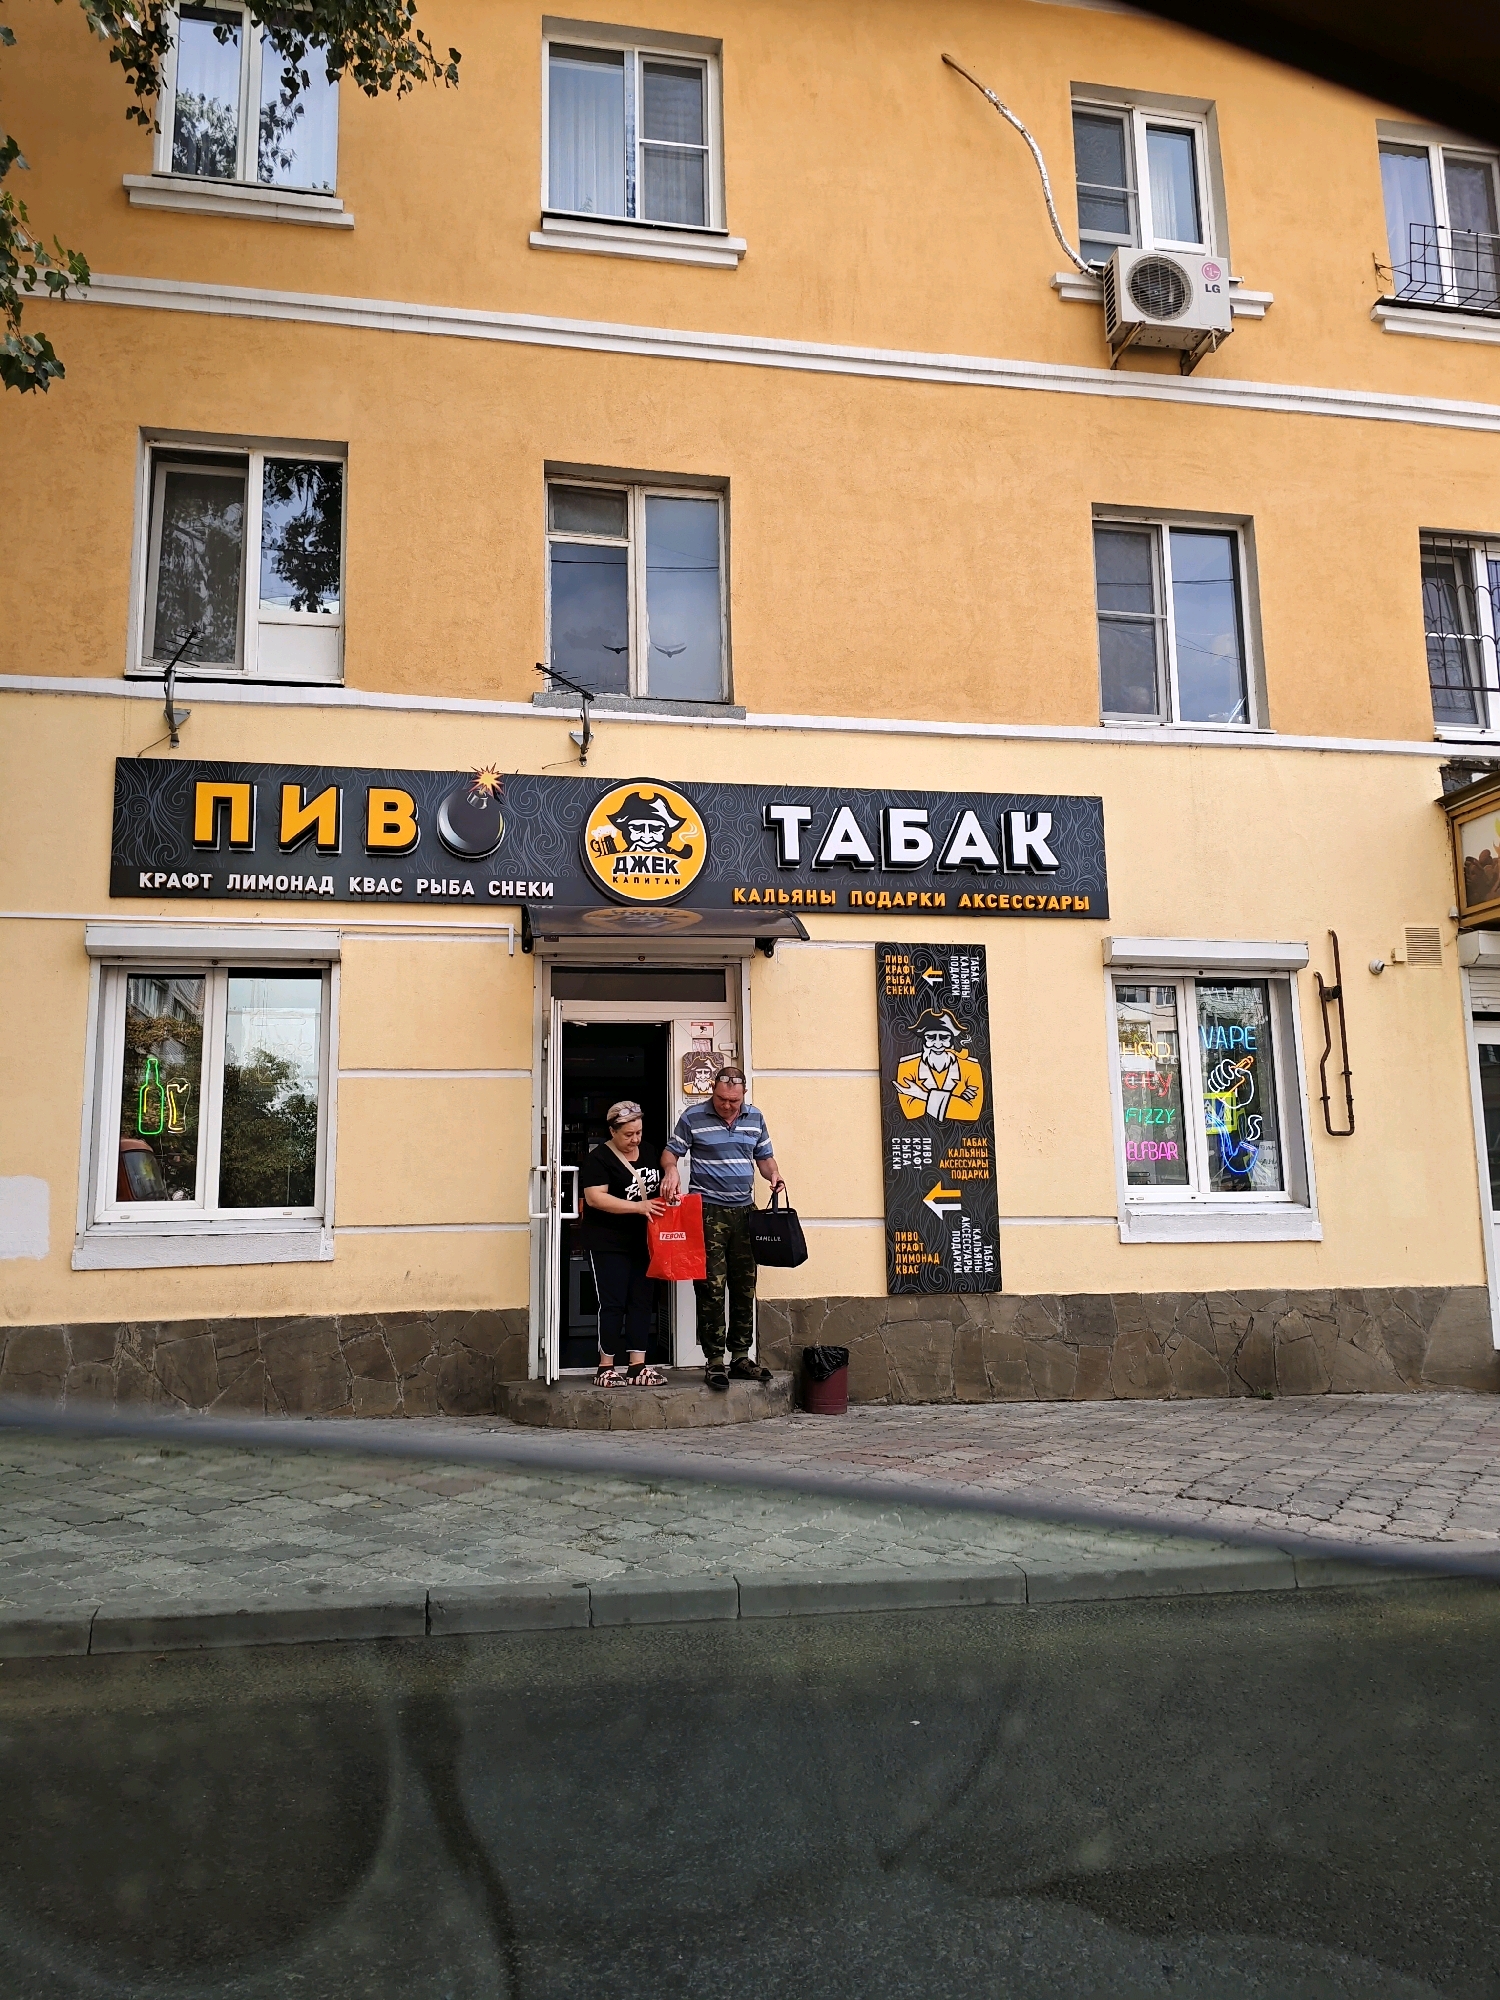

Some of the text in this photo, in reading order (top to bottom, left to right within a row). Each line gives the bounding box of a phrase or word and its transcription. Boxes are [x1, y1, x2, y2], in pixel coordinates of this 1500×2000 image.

[1205, 283, 1221, 294] LG
[766, 804, 1062, 873] ТАБАК
[612, 855, 680, 875] ДЖЕК
[138, 871, 555, 897] КРАФТ ЛИМОНАД КВАС РЫБА СНЕКИ
[612, 876, 681, 886] КАПИТАН
[733, 887, 1090, 911] КАЛЬЯНЫ ПОДАРКИ АКСЕССУАРЫ
[885, 955, 909, 964] ПИВО
[971, 956, 980, 983] ТАБАК
[885, 965, 916, 975] КРАФТ
[885, 975, 911, 985] РЫБА
[950, 955, 960, 996] ПОДАРКИ
[959, 956, 971, 998] КАЛЬЯНЫ
[886, 985, 916, 995] СНЕКИ
[1200, 1025, 1258, 1050] VAPE
[1122, 1041, 1171, 1058] HQD
[1125, 1107, 1176, 1124] FIZZY
[902, 1137, 911, 1166] РЫБА
[922, 1137, 932, 1164] ПИВО
[962, 1137, 988, 1147] ТАБАК
[1126, 1141, 1179, 1161] ELFBAR
[891, 1137, 901, 1170] СНЕКИ
[912, 1137, 921, 1170] КРАФТ
[948, 1148, 988, 1158] КАЛЬЯНЫ
[939, 1159, 989, 1169] АКСЕССУАРЫ
[951, 1169, 989, 1180] ПОДАРКИ
[895, 1231, 918, 1241] ПИВО
[961, 1216, 972, 1273] АКСЕССУАРЫ
[895, 1242, 924, 1252] КРАФТ
[952, 1230, 962, 1274] ПОДАРКИ
[973, 1228, 983, 1273] КАЛЬЯНЫ
[895, 1253, 940, 1264] ЛИМОНАД
[984, 1244, 994, 1273] ТАБАК
[895, 1265, 919, 1275] КВАС
